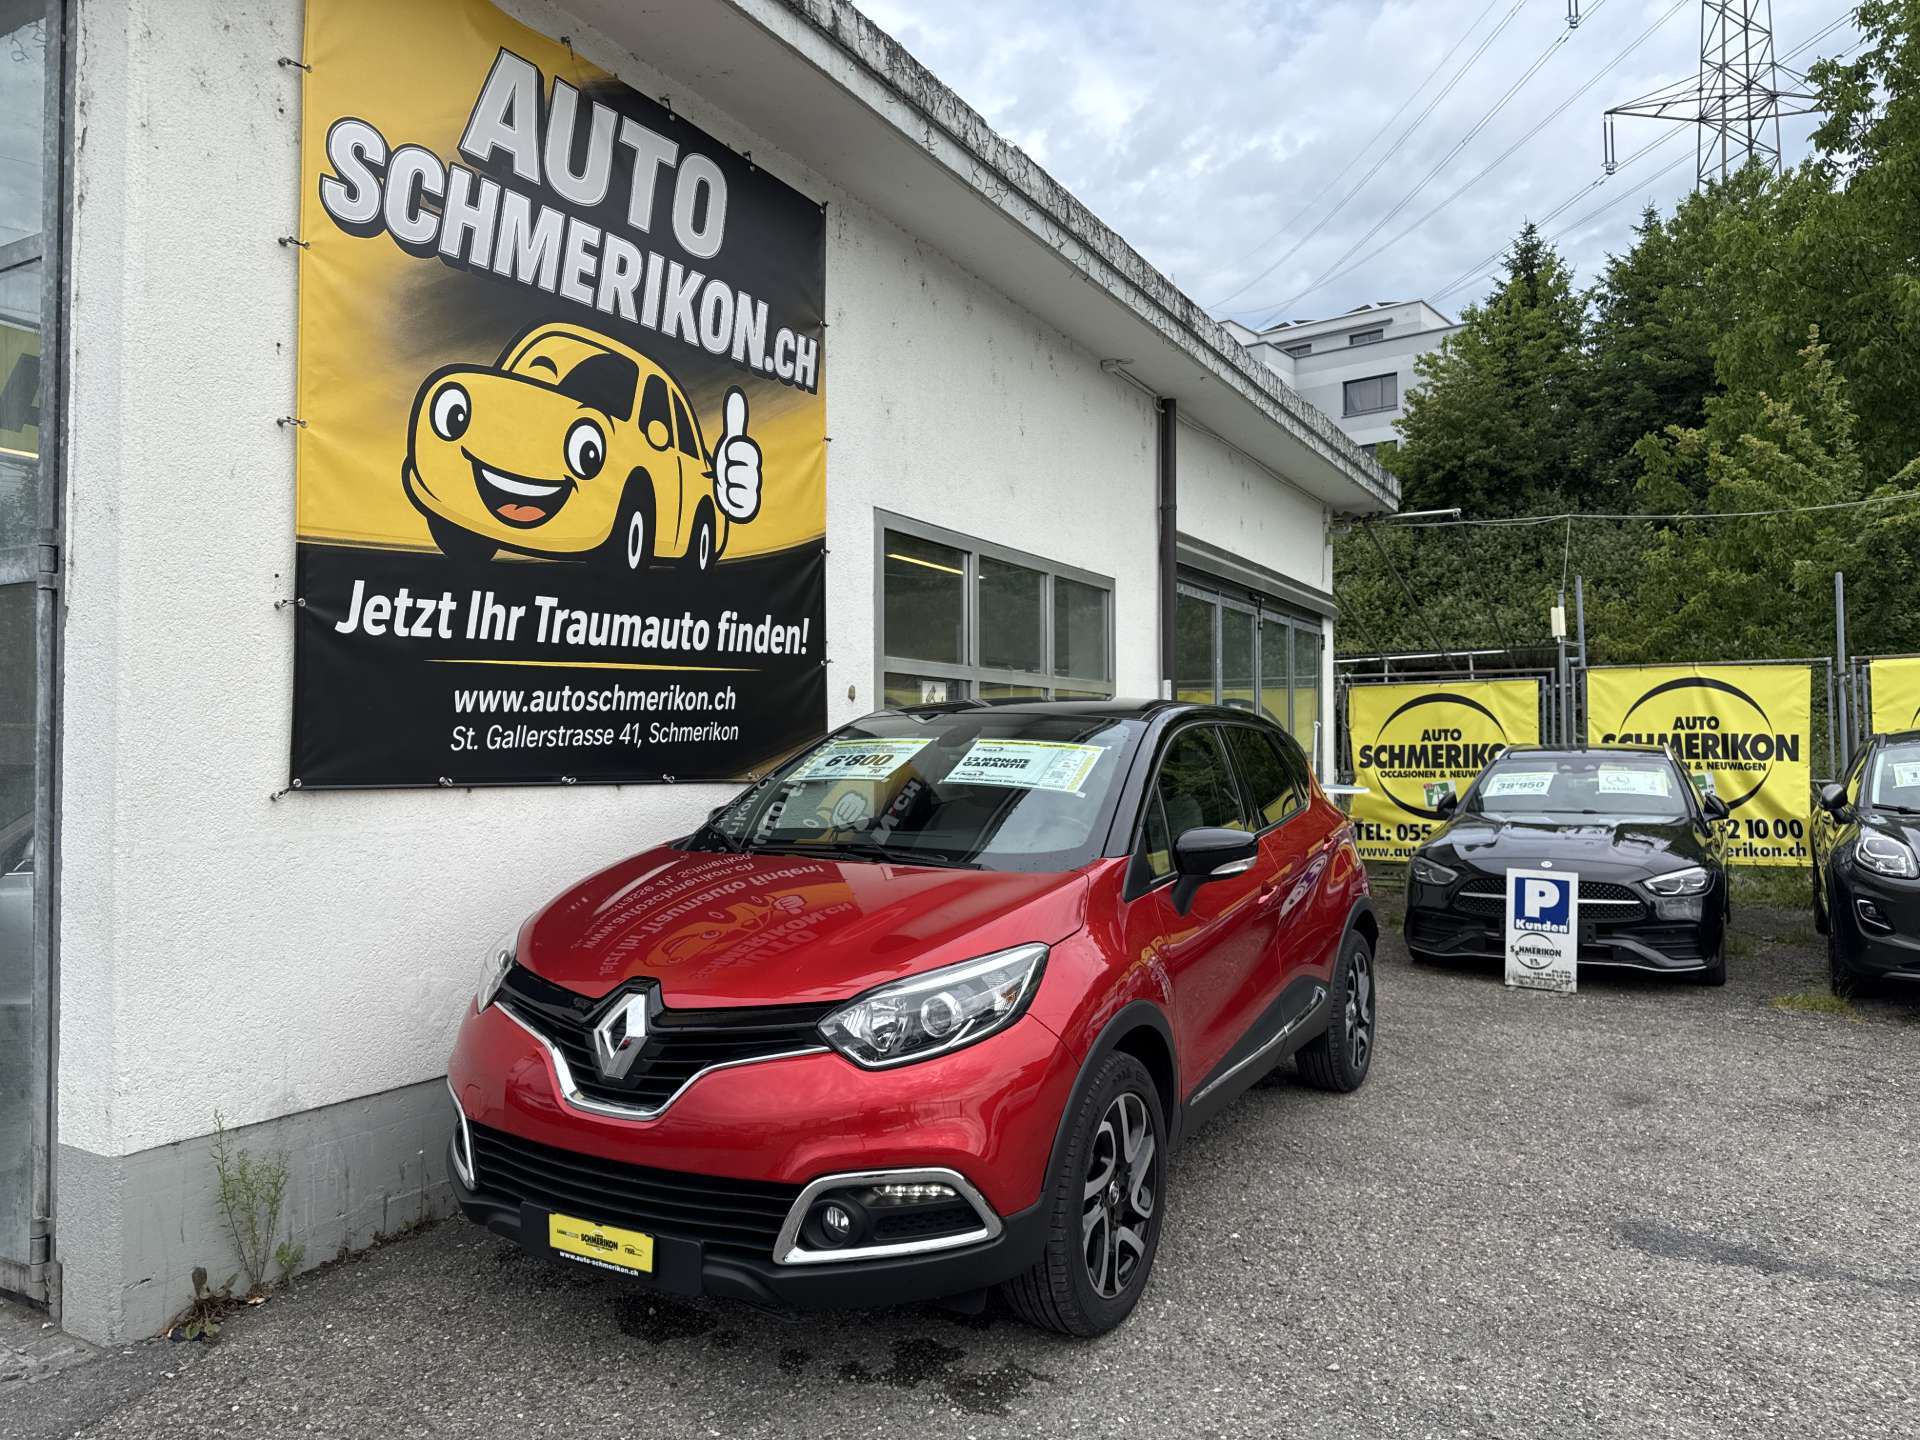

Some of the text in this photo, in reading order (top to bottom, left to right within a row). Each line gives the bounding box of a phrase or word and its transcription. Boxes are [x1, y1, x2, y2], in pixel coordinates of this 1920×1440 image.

[459, 47, 728, 260] AUTO
[320, 117, 819, 390] SCHMERIKON.CH
[335, 580, 809, 655] Jetzt Ihr Traumauto finden!
[454, 684, 736, 714] www.autoschmerikon.ch
[1673, 716, 1720, 730] AUTO
[450, 722, 739, 751] St. Gallerstrasse 41, Schmerikon
[1421, 729, 1462, 741] AUTO
[825, 754, 894, 767] 6'800
[962, 761, 1028, 769] GARANTIE
[1359, 743, 1508, 769] SCHMERIKO
[1380, 770, 1437, 778] OCCASIONEN
[1694, 762, 1703, 770] &
[1707, 762, 1766, 771] NEUWAGEN
[1355, 824, 1391, 841] TEL:
[1744, 819, 1768, 839] 10
[1773, 819, 1803, 839] 00
[1524, 879, 1560, 918] P
[1515, 919, 1568, 933] Kunden
[580, 1233, 618, 1250] SCHMERIKON
[560, 1251, 639, 1277] www.auto-schmerikon.ch
